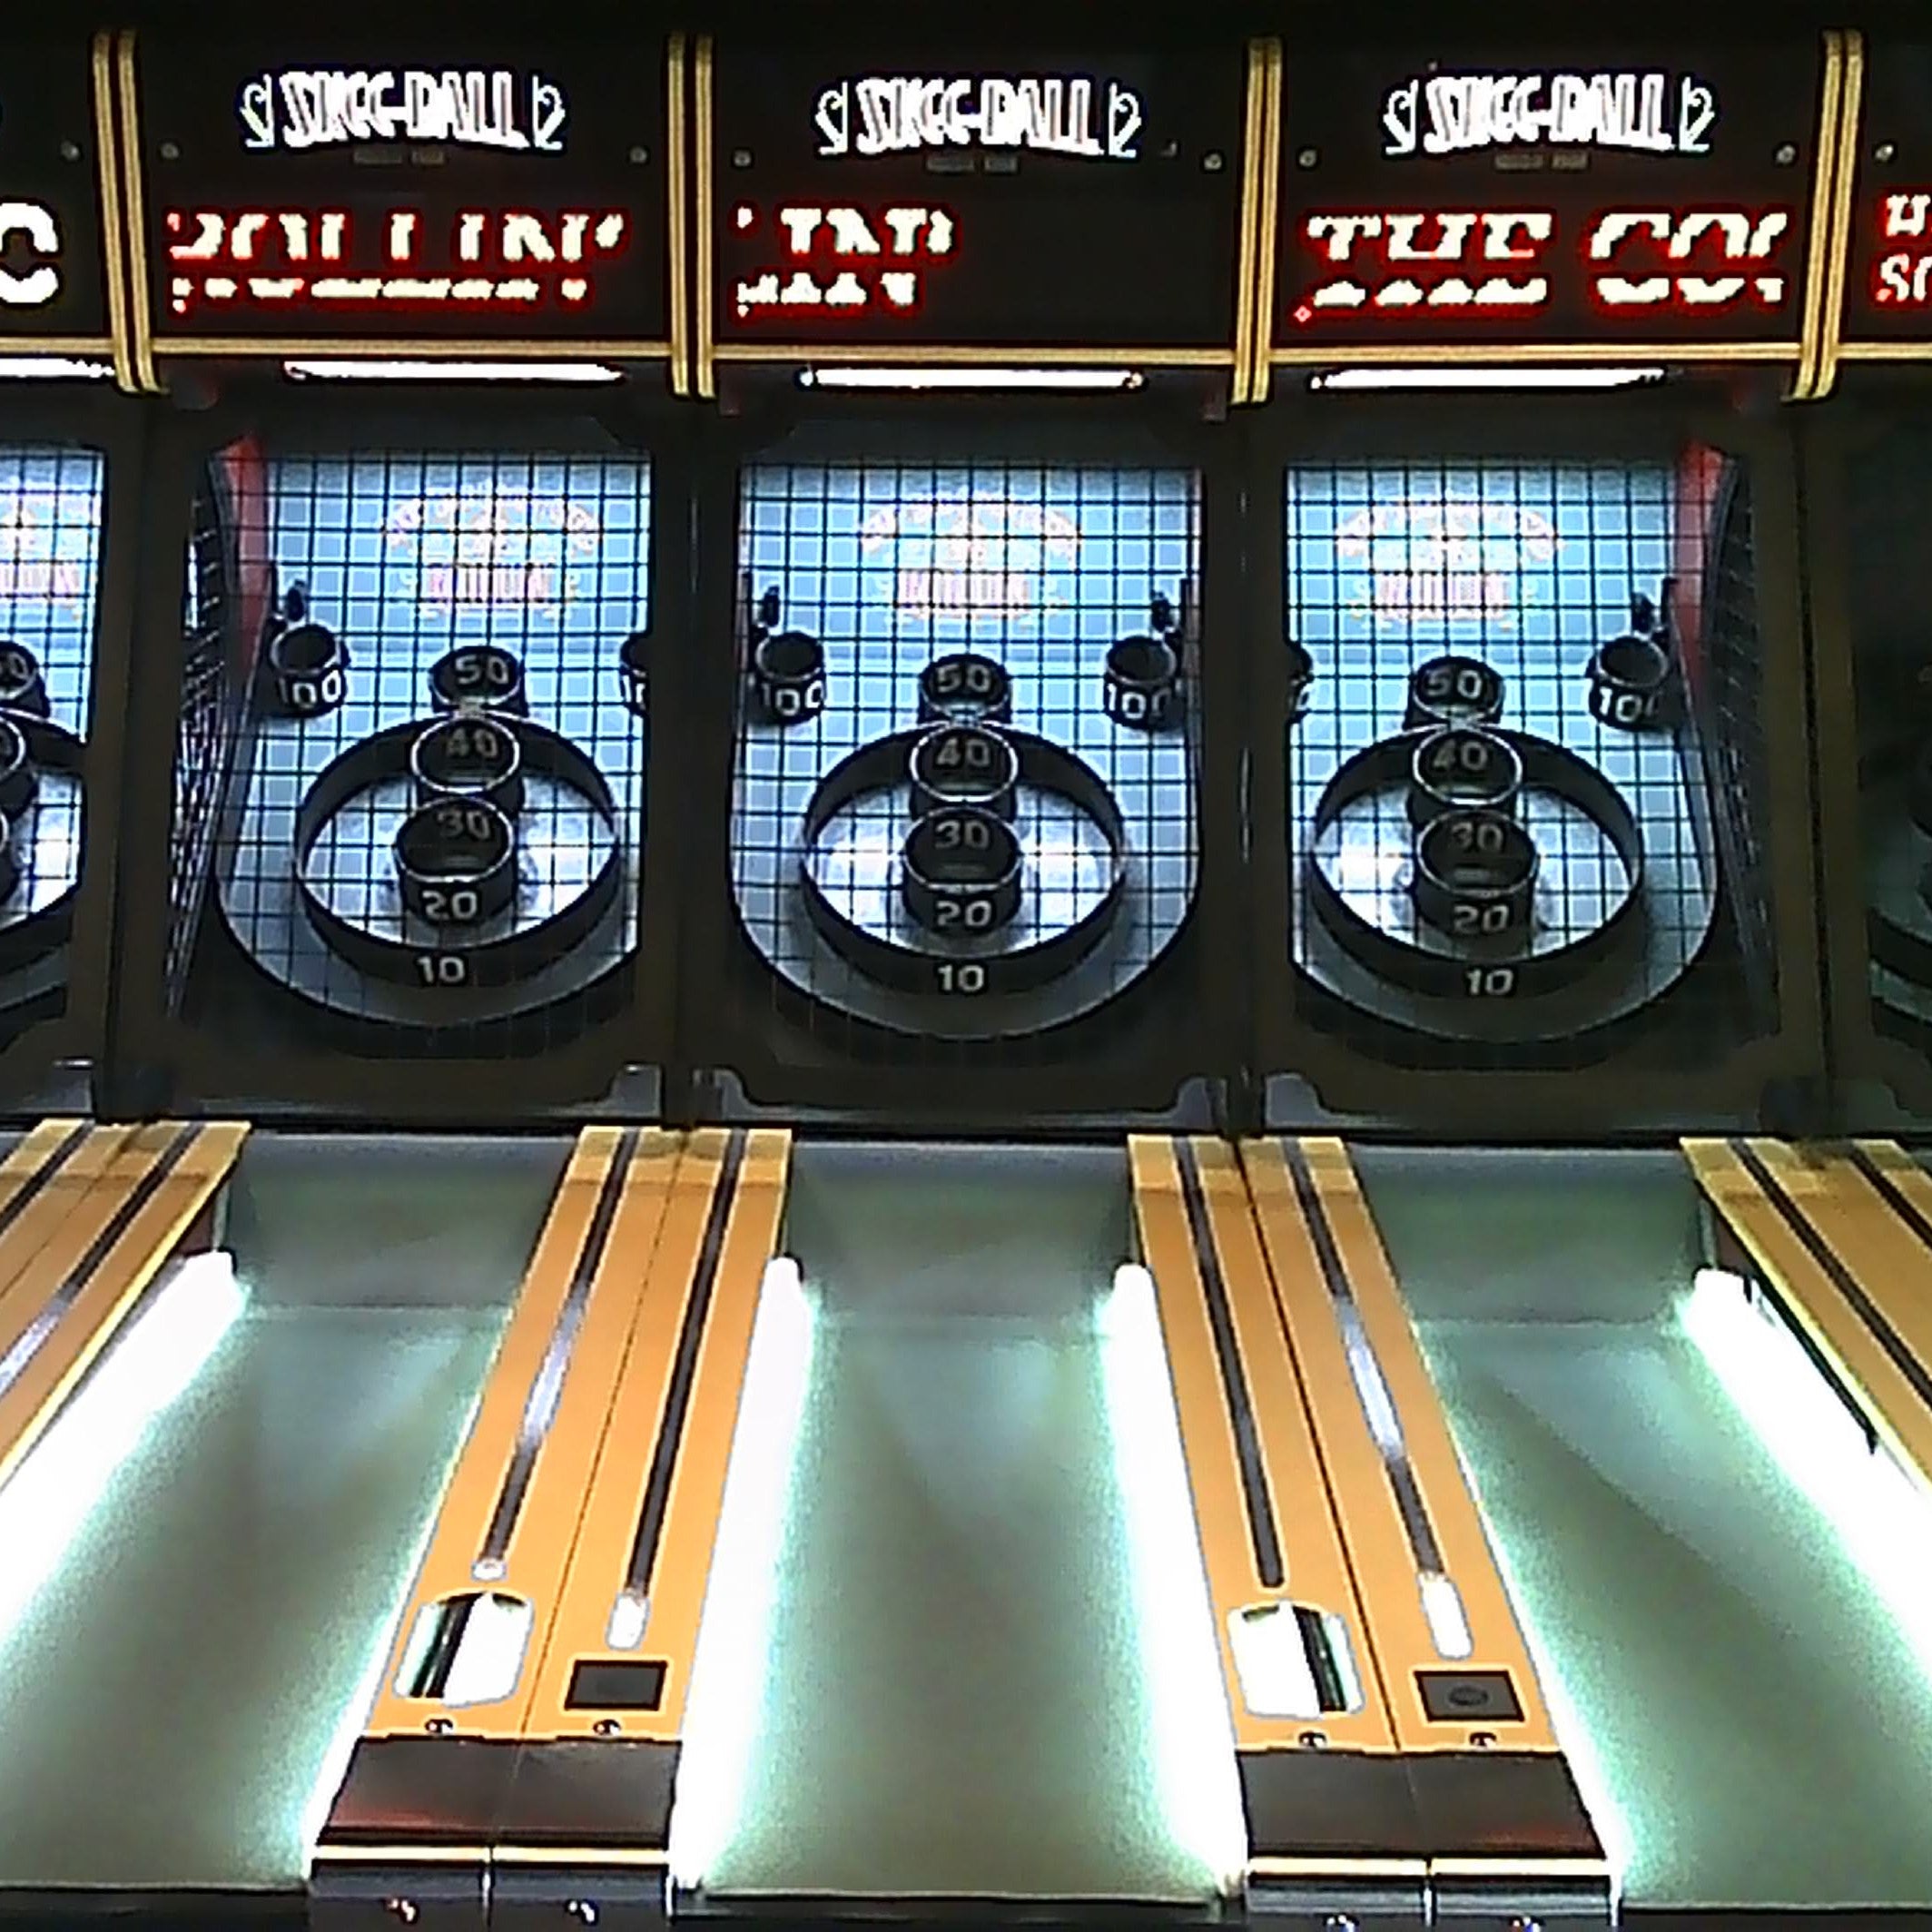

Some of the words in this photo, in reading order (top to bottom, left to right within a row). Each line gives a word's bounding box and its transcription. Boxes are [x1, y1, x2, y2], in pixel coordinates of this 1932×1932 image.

[457, 657, 509, 685] 50
[937, 666, 992, 693] 50
[1426, 668, 1484, 698] 50
[446, 727, 498, 757] 40
[937, 737, 991, 767] 40
[1433, 740, 1489, 771] 40
[933, 820, 991, 849] 30
[1453, 822, 1503, 852] 30
[421, 890, 478, 921] 20
[937, 901, 992, 928] 20
[1454, 905, 1510, 935] 20
[416, 956, 467, 983] 10
[937, 964, 985, 991] 10
[1466, 969, 1514, 996] 10
